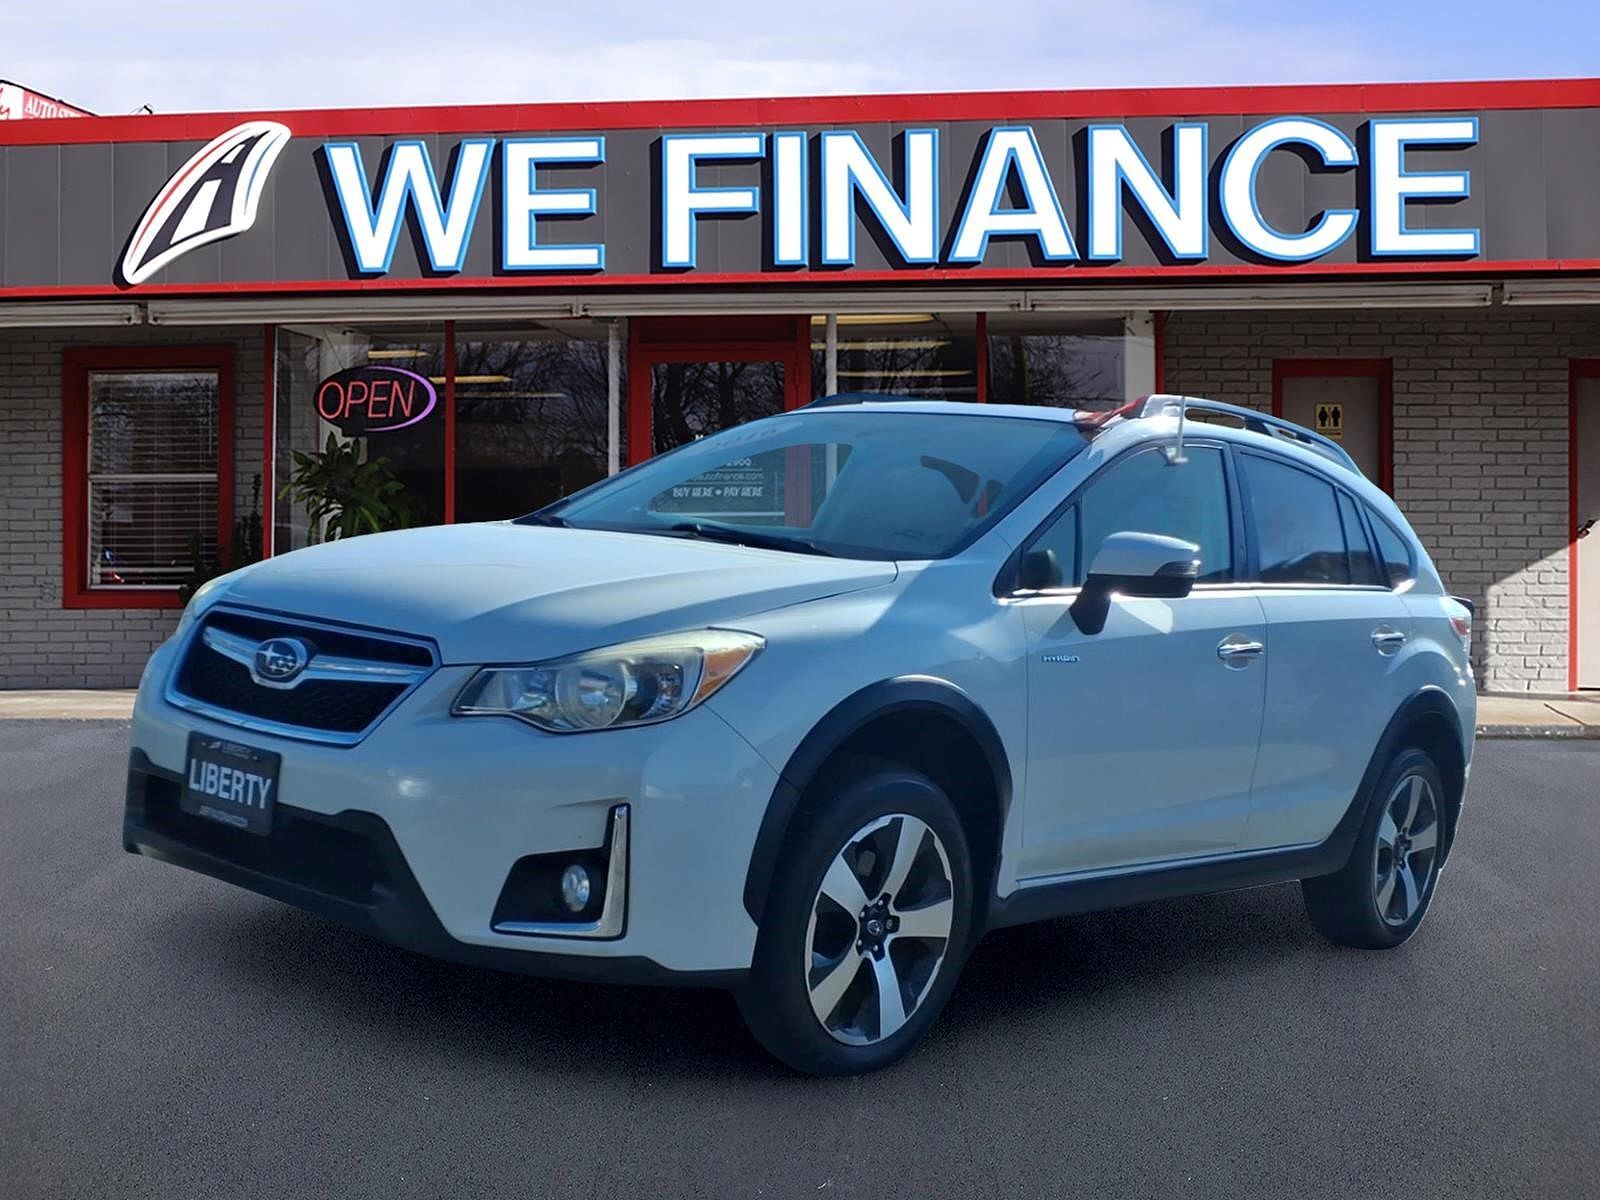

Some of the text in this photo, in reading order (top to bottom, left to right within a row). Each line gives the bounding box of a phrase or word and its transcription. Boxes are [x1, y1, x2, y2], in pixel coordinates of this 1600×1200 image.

[322, 116, 1481, 273] WE FINANCE
[318, 380, 415, 419] OPEN
[672, 486, 764, 498] BUY HERE PAY HERE
[189, 758, 272, 810] LIBERTY
